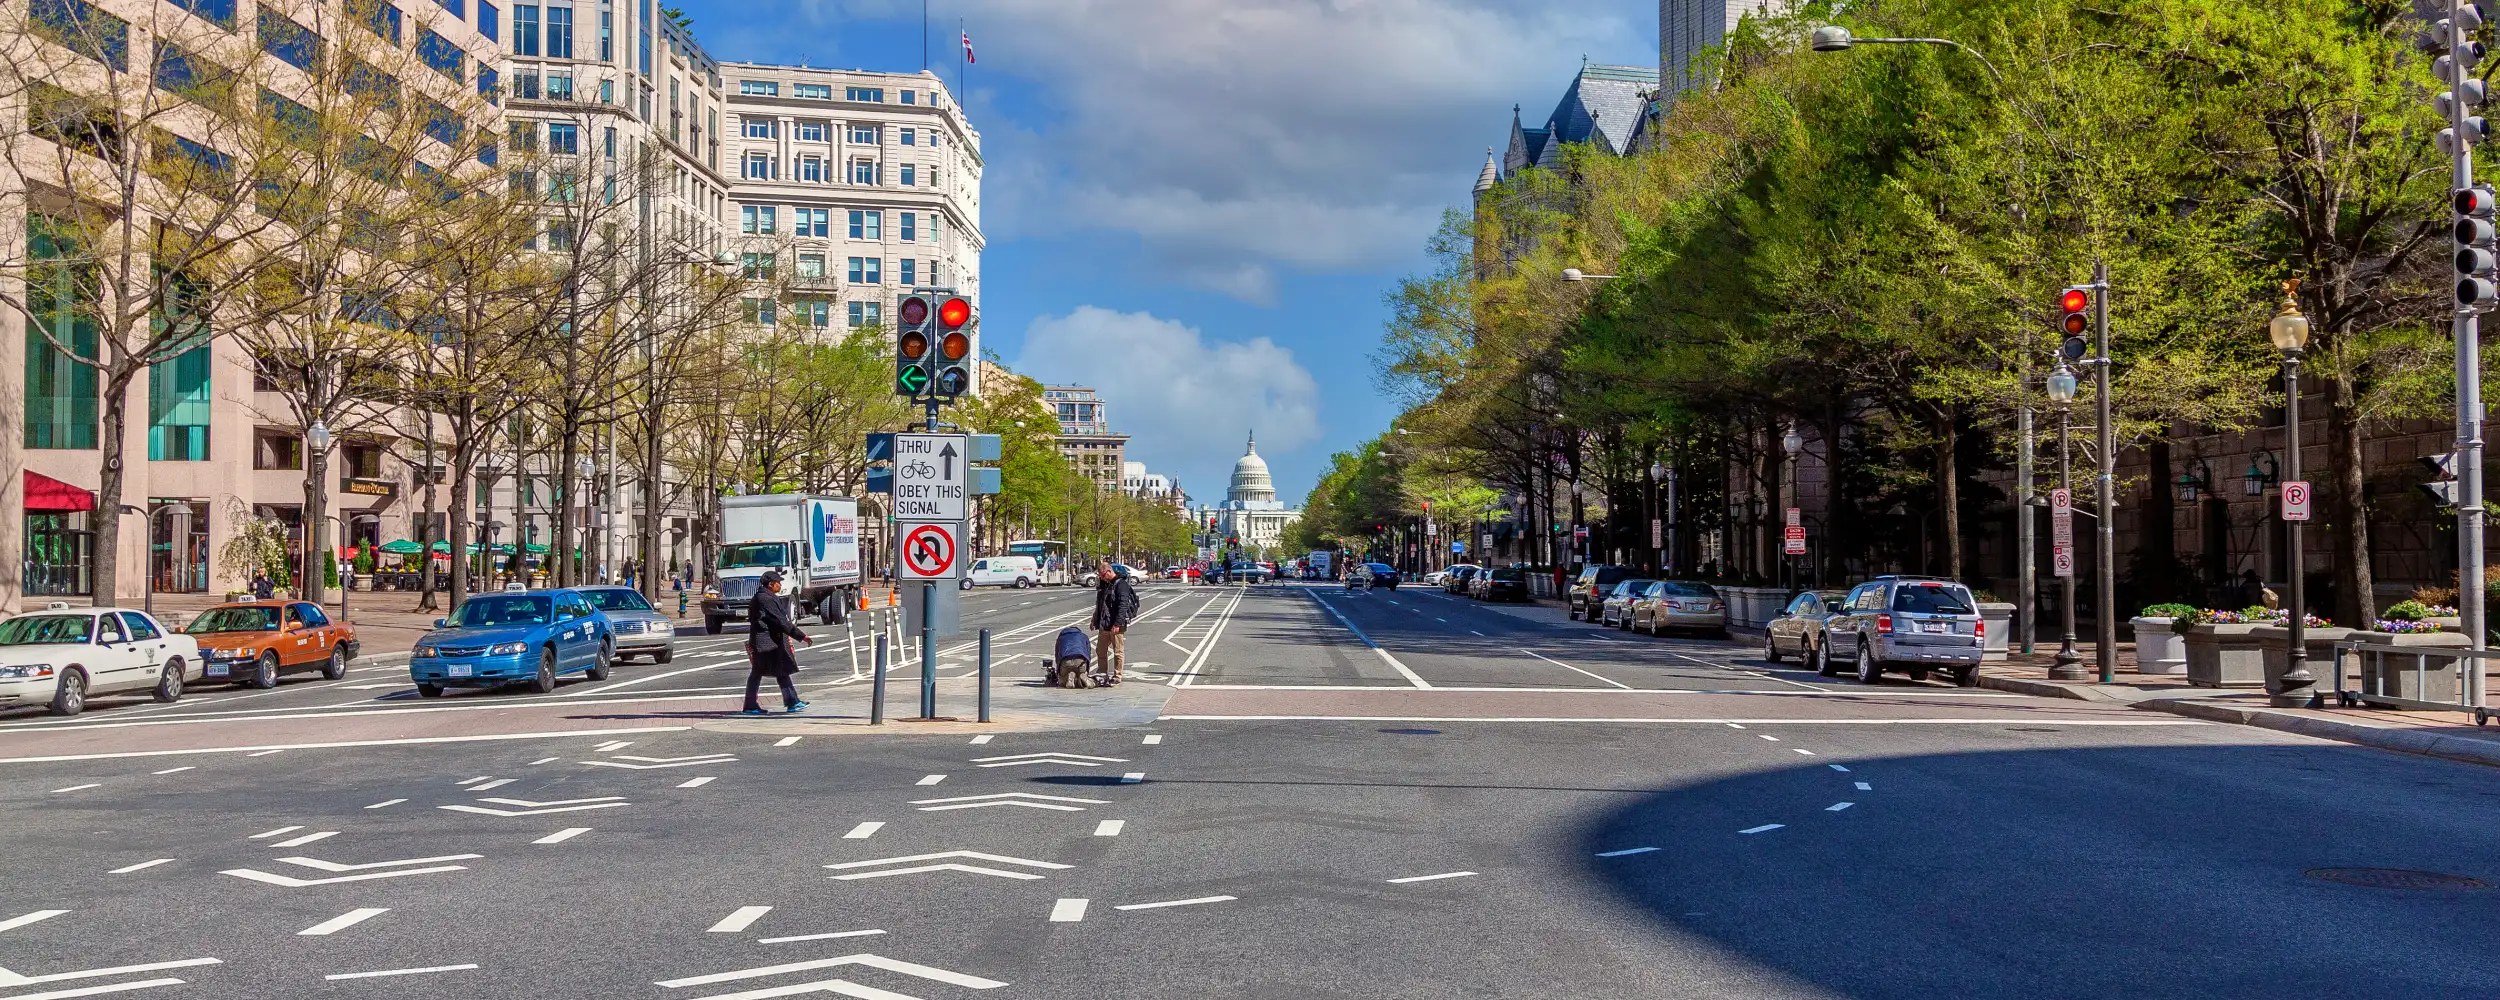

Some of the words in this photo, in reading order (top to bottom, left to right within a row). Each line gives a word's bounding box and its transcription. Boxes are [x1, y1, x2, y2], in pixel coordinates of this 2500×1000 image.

[900, 440, 932, 453] THRU
[899, 485, 930, 498] OBEY
[936, 485, 961, 498] THIS
[898, 501, 941, 514] SIGNAL
